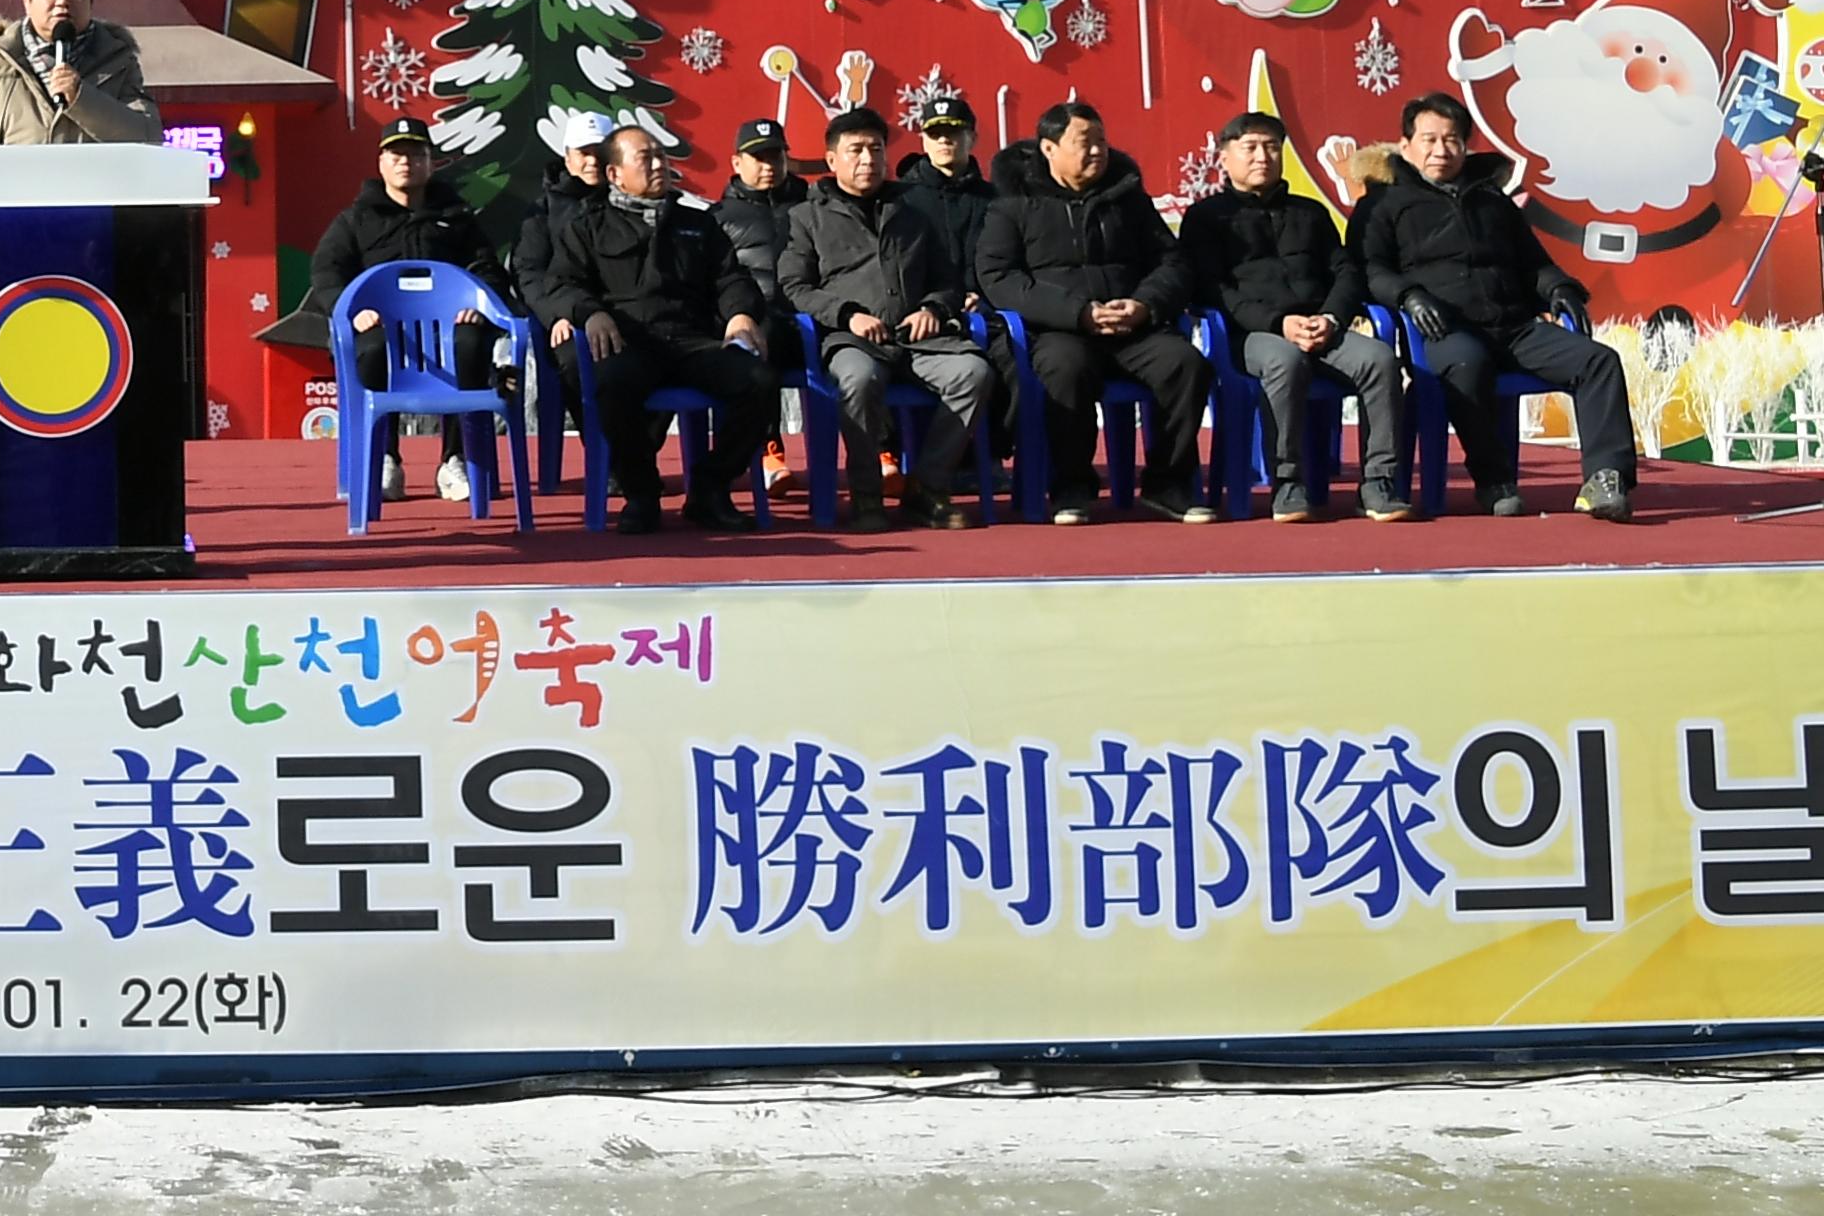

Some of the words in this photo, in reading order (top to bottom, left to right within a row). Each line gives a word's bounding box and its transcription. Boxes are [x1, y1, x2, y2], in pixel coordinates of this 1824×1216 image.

[304, 382, 338, 395] POS
[3, 978, 88, 1029] 01.
[121, 971, 288, 1036] 22(화)
